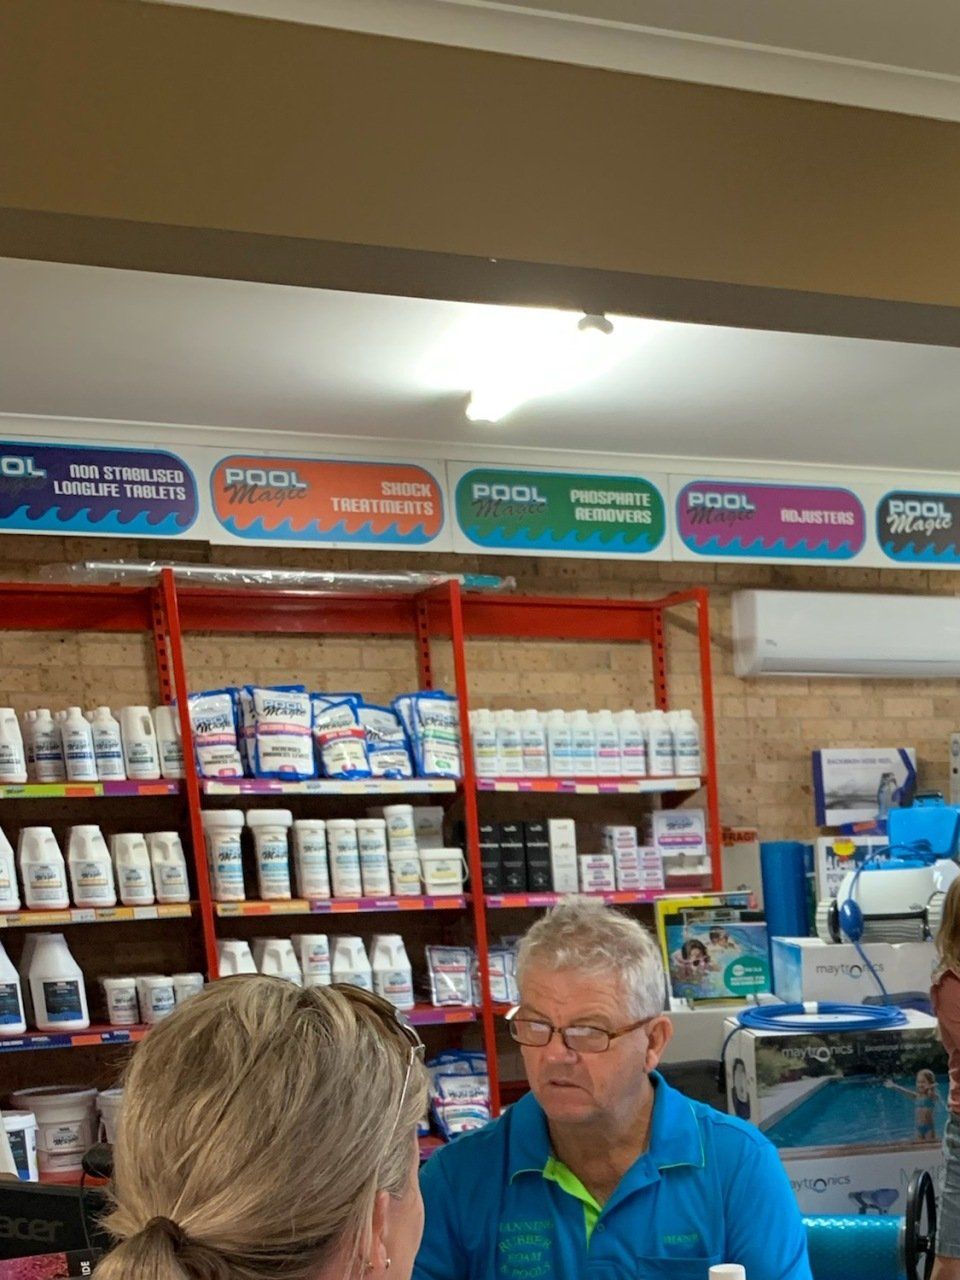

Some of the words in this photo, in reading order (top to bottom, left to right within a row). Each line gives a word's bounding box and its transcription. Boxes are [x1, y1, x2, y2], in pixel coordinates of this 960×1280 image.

[70, 464, 99, 479] NON
[104, 466, 184, 484] STABILISED
[225, 468, 307, 488] POOL
[54, 480, 120, 497] LONGLIFE
[124, 485, 186, 500] TABLETS
[224, 483, 307, 507] Magic
[381, 481, 432, 497] SHOCK
[472, 483, 547, 503] POOL
[570, 489, 651, 507] PHOSPHATE
[330, 497, 433, 515] TREATMENTS
[471, 498, 546, 519] Magic
[688, 491, 755, 510] POOL
[889, 499, 952, 518] POOL
[575, 507, 652, 524] REMOVERS
[686, 505, 755, 527] Magic
[781, 508, 855, 526] ADJUSTERS
[886, 513, 952, 536] Magic
[782, 1043, 853, 1062] maytronics
[790, 1174, 850, 1193] aytronics
[0, 1216, 63, 1242] acer
